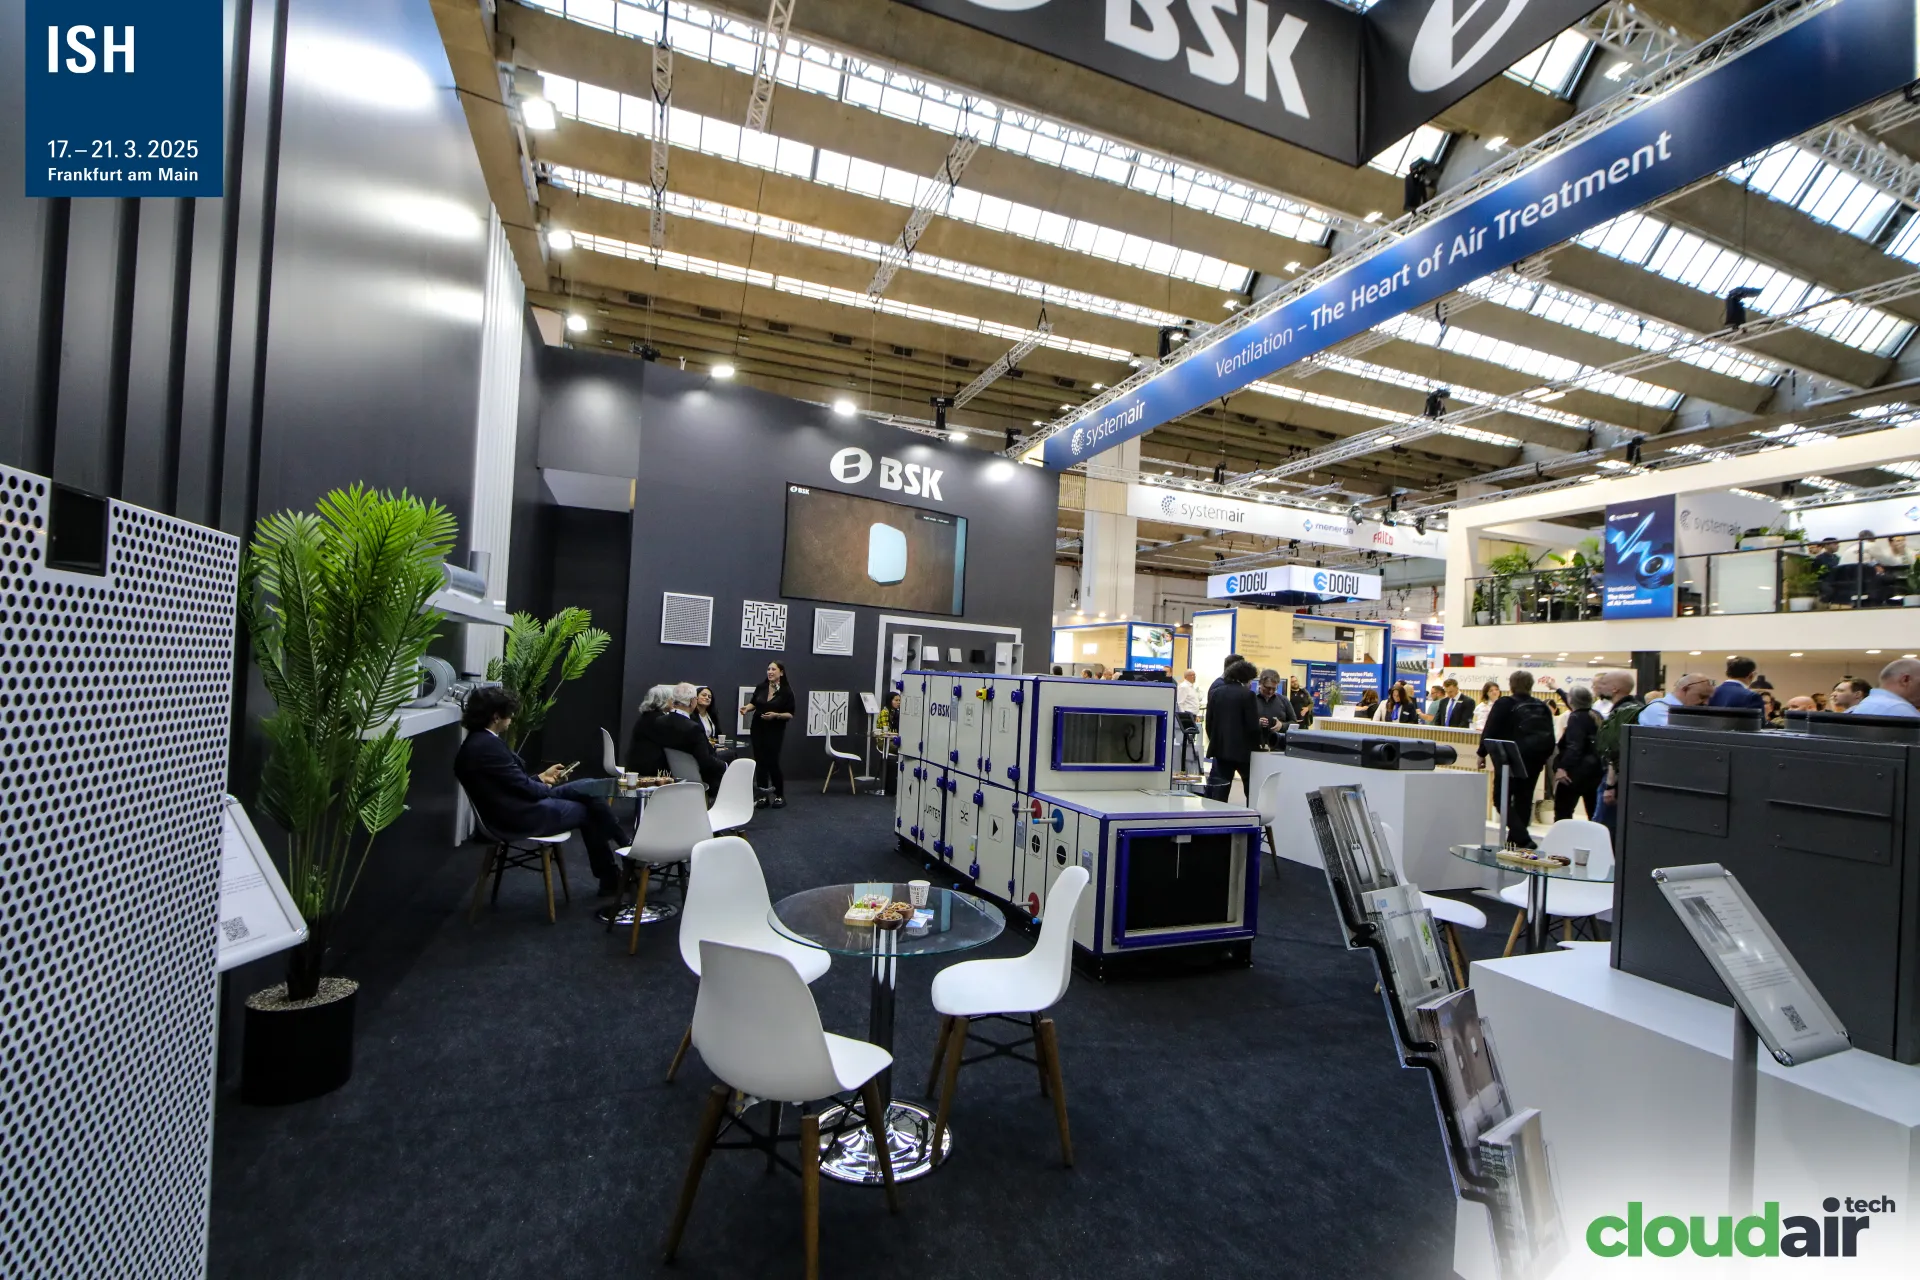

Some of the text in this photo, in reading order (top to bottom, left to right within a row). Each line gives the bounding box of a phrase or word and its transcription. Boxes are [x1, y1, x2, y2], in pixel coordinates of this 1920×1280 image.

[1215, 326, 1293, 378] Ventilation
[1310, 301, 1345, 332] The
[1350, 263, 1411, 309] Heart
[1416, 242, 1445, 279] of
[1447, 225, 1489, 266] Air
[1494, 129, 1674, 241] Treatment
[1086, 399, 1146, 448] systemair
[879, 456, 944, 501] BSK
[1180, 501, 1245, 524] systemair
[1314, 523, 1354, 536] menerga
[937, 704, 950, 718] BSK
